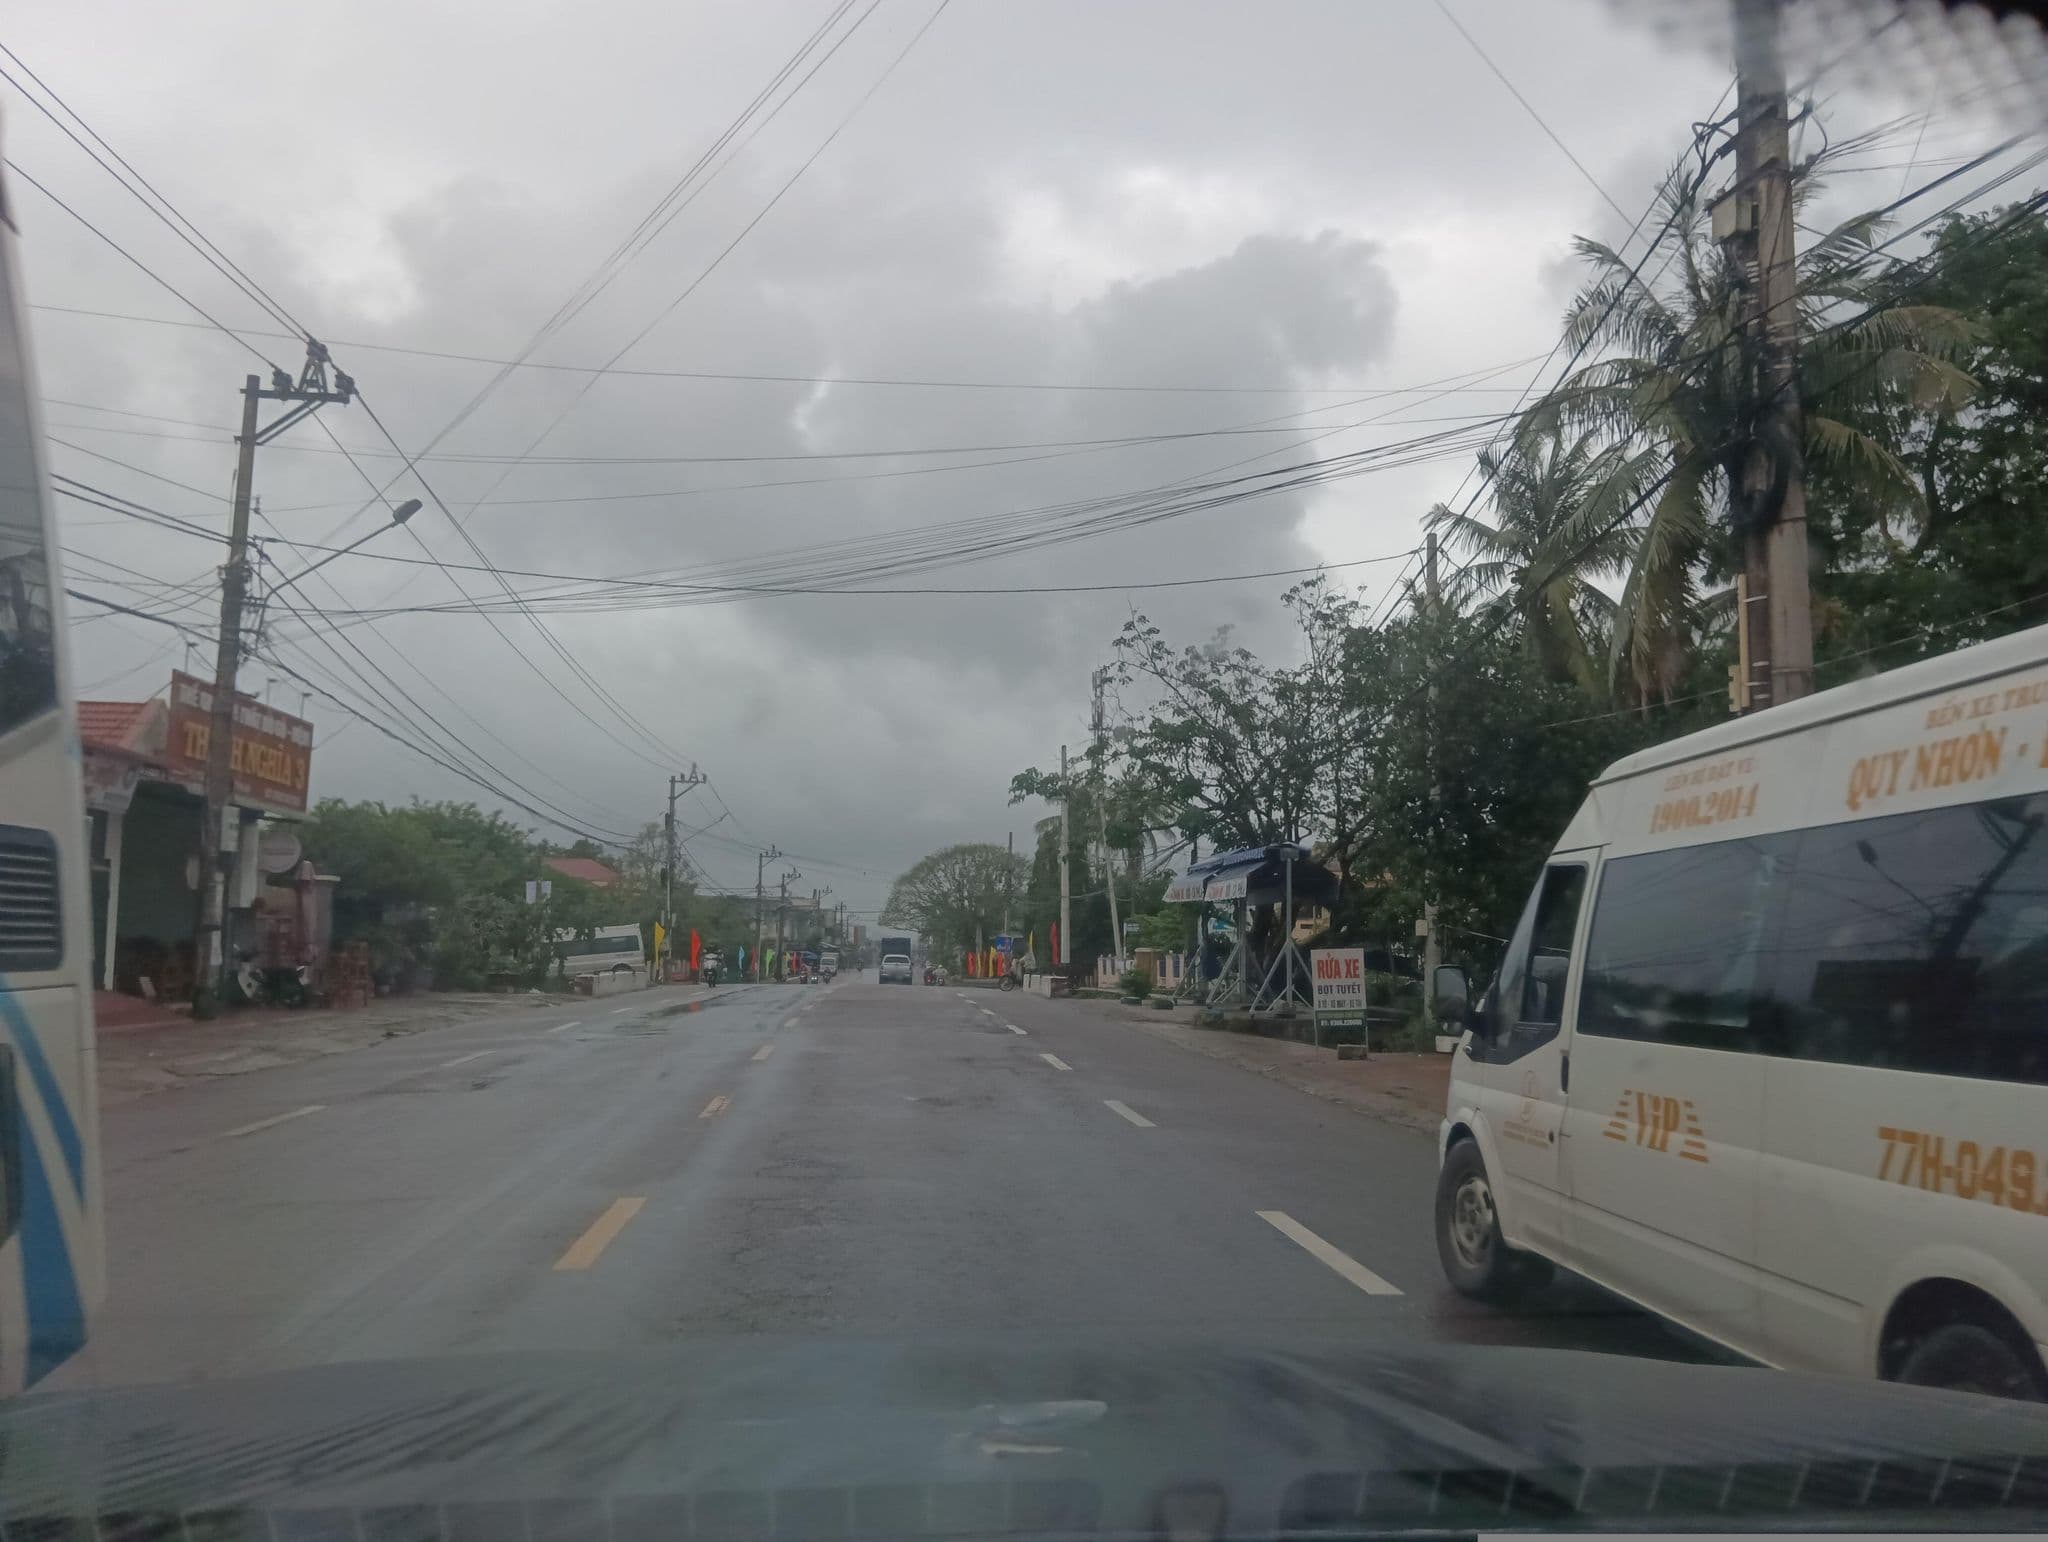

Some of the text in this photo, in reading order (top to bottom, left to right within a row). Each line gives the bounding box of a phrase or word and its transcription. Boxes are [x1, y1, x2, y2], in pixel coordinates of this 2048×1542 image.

[183, 719, 243, 772] THH
[1846, 749, 1909, 811] QUY
[1316, 952, 1361, 980] RỬA XE
[1636, 1091, 1680, 1153] VIP
